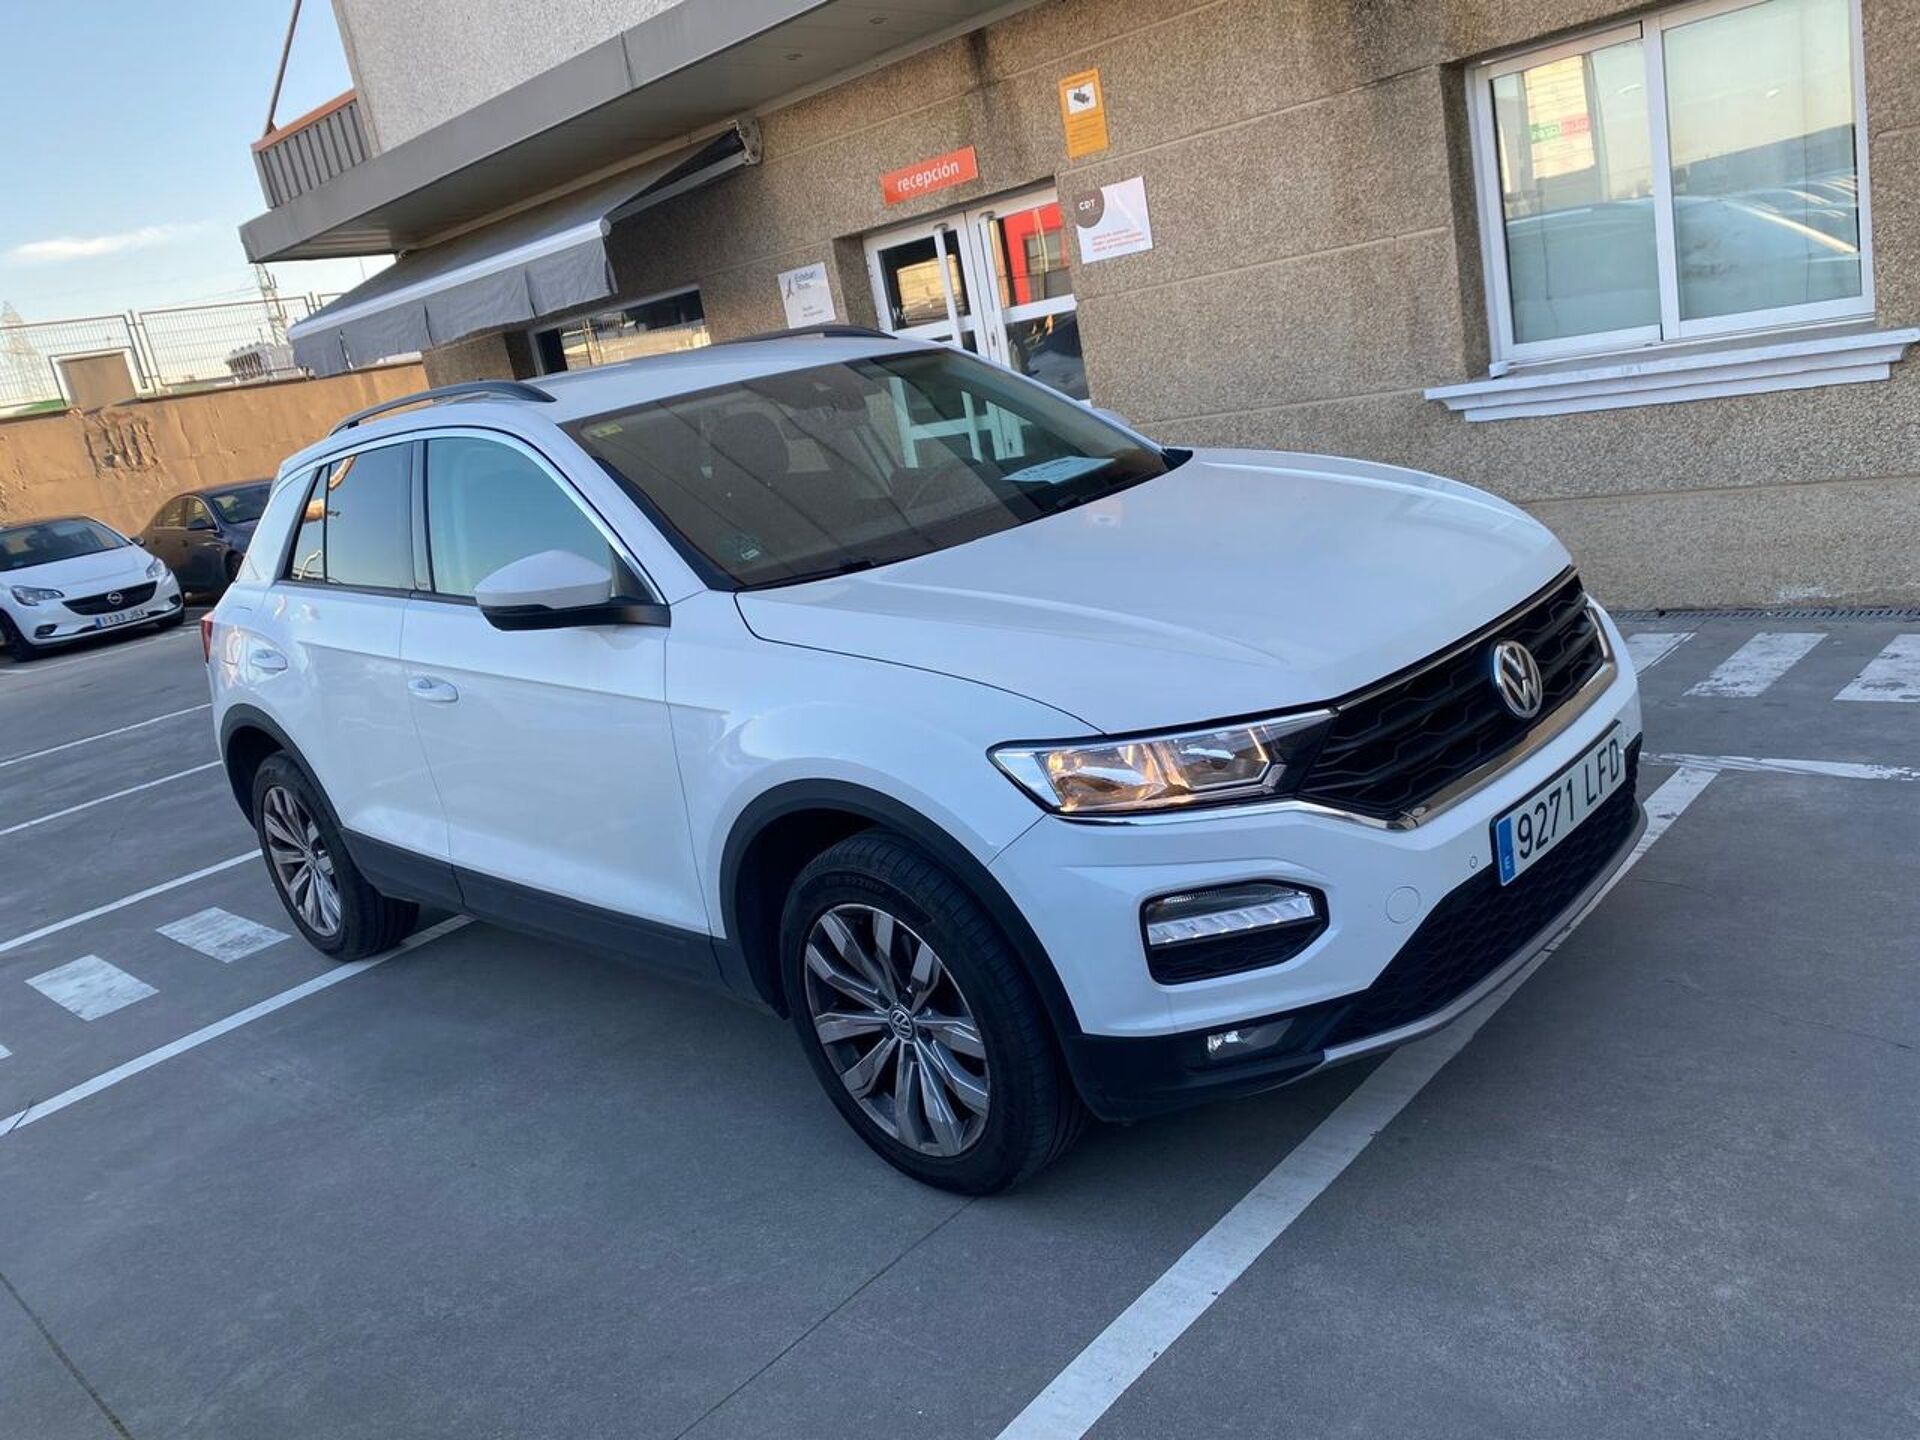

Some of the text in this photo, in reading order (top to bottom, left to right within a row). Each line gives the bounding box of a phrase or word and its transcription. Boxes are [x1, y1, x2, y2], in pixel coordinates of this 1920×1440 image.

[897, 160, 960, 192] recepción
[1517, 779, 1574, 860] 9271
[1585, 738, 1620, 807] LFD
